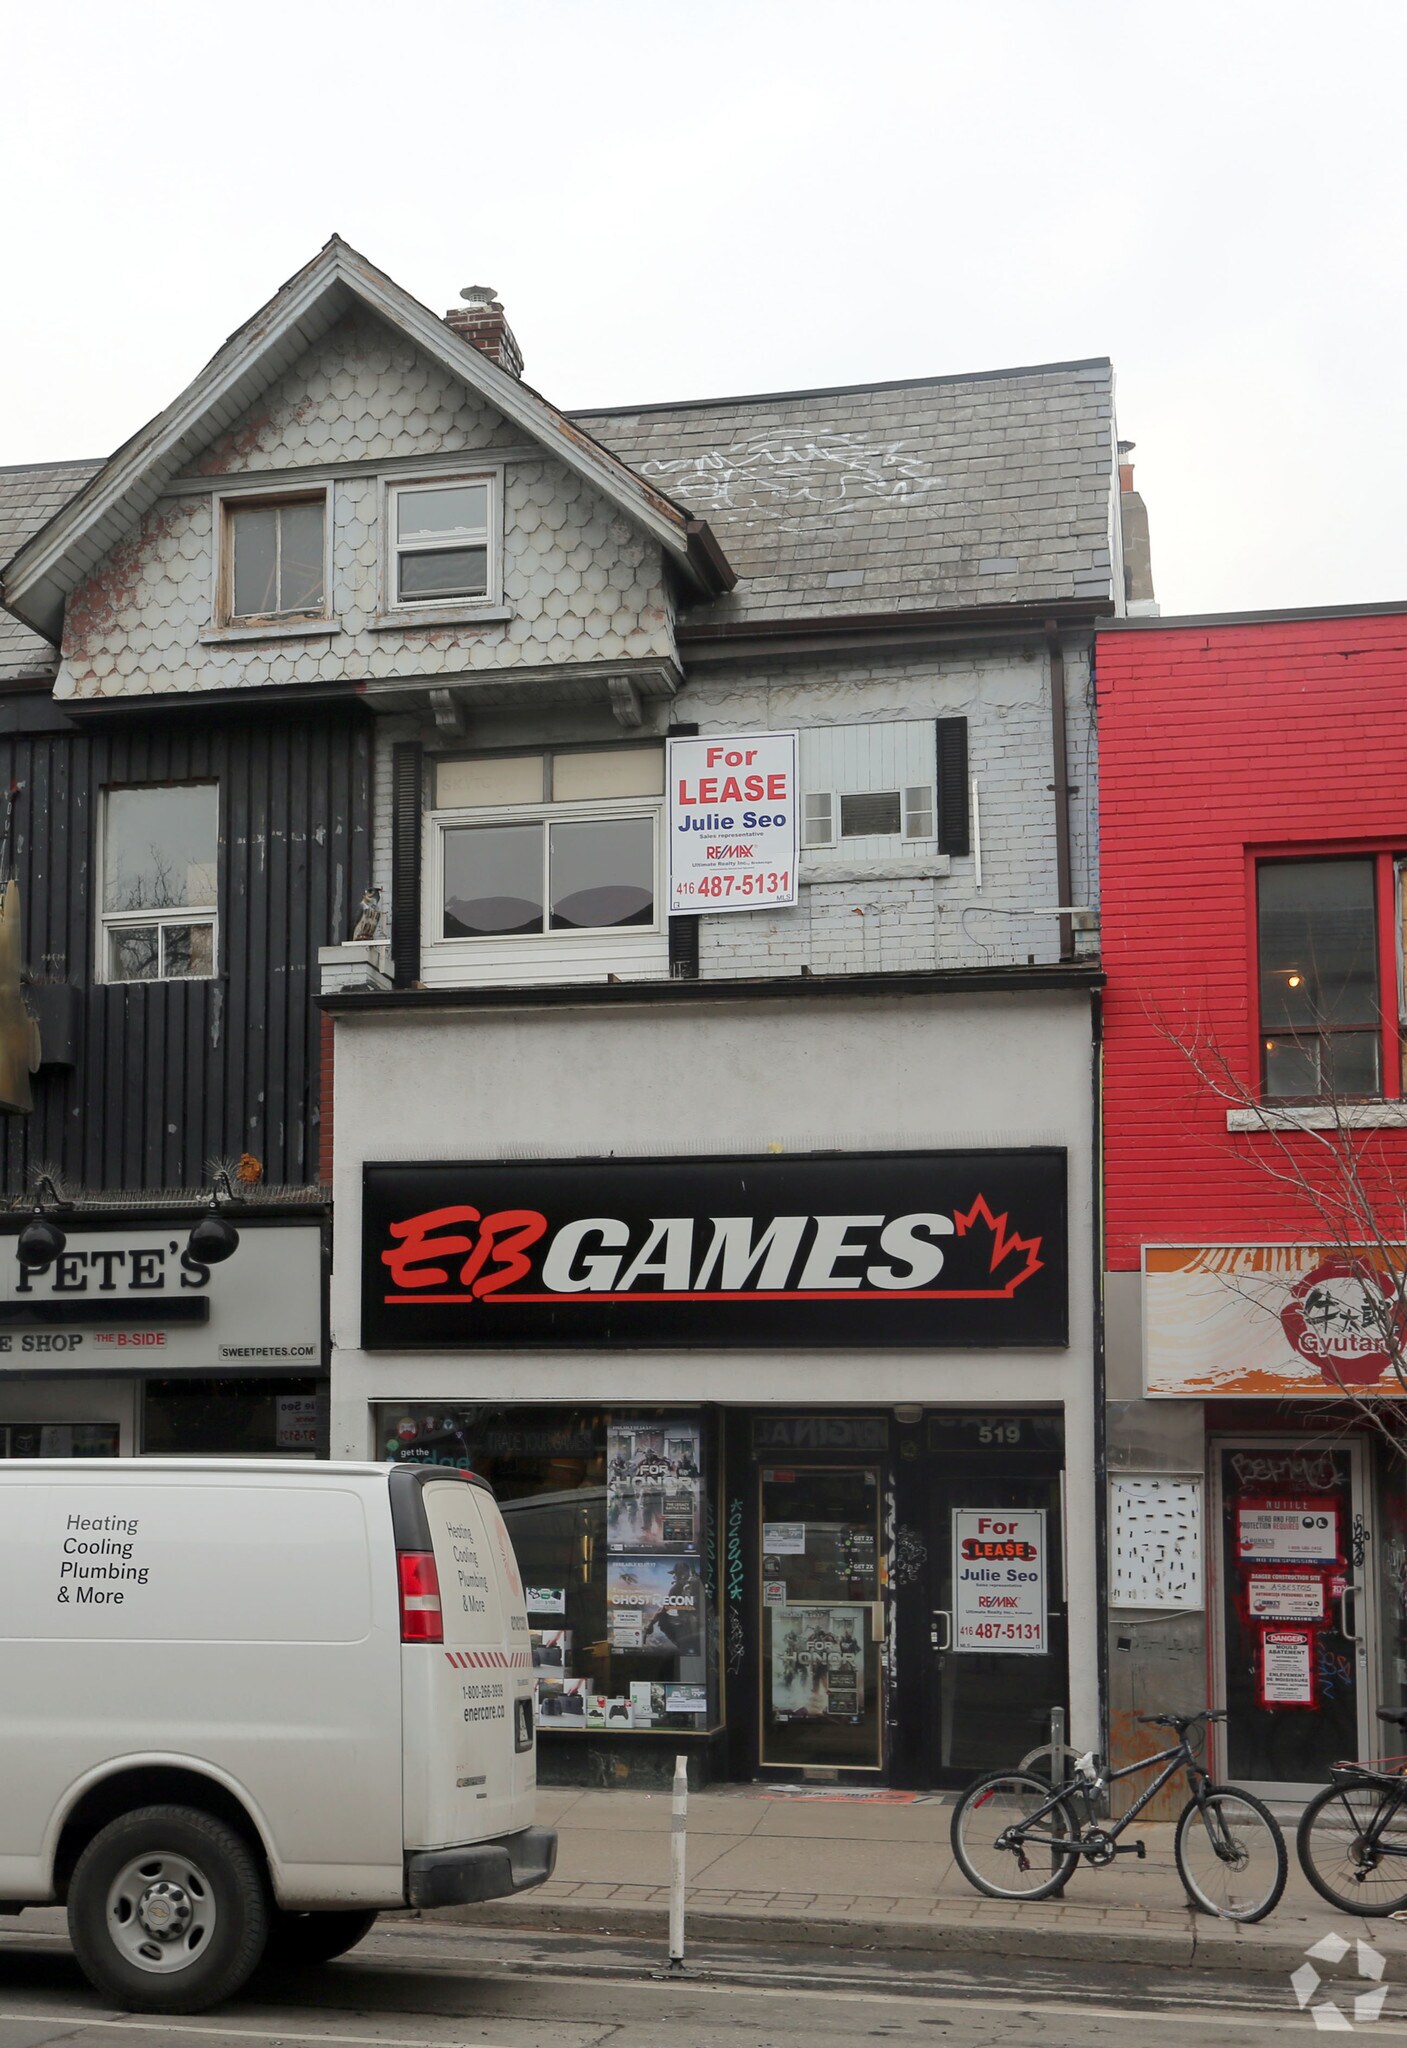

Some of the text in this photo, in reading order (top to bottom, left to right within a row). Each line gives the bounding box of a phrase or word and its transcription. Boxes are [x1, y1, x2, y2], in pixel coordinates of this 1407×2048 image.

[706, 747, 758, 768] For
[679, 774, 787, 805] LEASE
[678, 811, 787, 832] Julie Seo
[718, 831, 764, 839] representative
[706, 844, 754, 860] RE/MAX
[717, 860, 736, 868] Realty
[676, 871, 789, 898] 416 487-5131
[380, 1205, 956, 1298] EB GAMES
[15, 1241, 211, 1292] PETE'S
[22, 1334, 83, 1352] SHOP
[96, 1332, 165, 1346] THE B-SIDE
[222, 1346, 314, 1357] SWEETPETES.COM
[978, 1426, 1020, 1444] 519
[400, 1448, 430, 1458] get the
[640, 1465, 668, 1475] FOR
[613, 1476, 694, 1492] HONOR
[1266, 1500, 1309, 1510] NOTICE
[66, 1514, 139, 1536] Heating
[446, 1521, 474, 1544] Heating
[978, 1518, 1018, 1534] For
[63, 1537, 134, 1559] Cooling
[453, 1545, 478, 1568] Cooling
[974, 1543, 1025, 1556] LEASE
[60, 1561, 150, 1584] Plumbing
[960, 1568, 1038, 1582] Julie Seo
[458, 1570, 488, 1593] Plumbing
[57, 1586, 124, 1604] & More
[462, 1595, 485, 1612] & More
[611, 1594, 694, 1607] GHOST RECON
[978, 1596, 1018, 1608] RE/MAX
[960, 1623, 1041, 1640] 416 487-5131
[1270, 1635, 1303, 1643] DANGER
[806, 1641, 833, 1651] FOR
[780, 1651, 857, 1667] HONOR
[464, 1704, 505, 1722] enercare.ca
